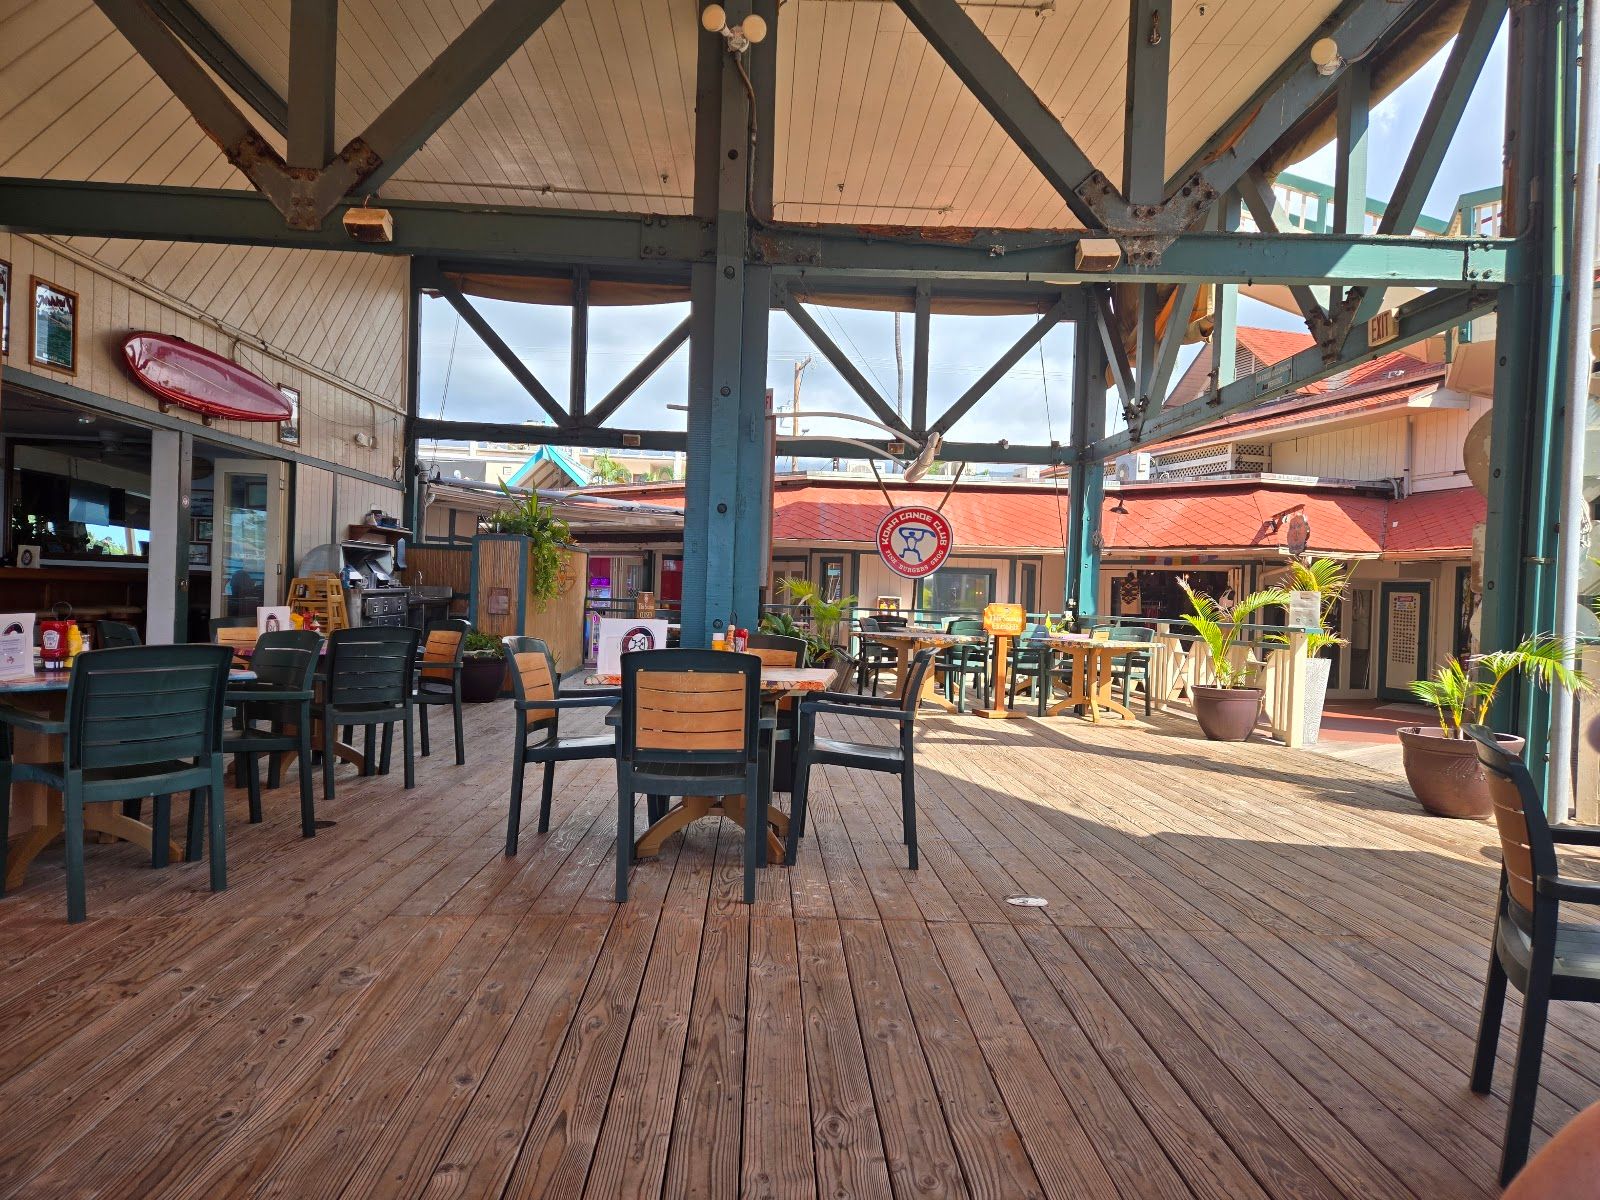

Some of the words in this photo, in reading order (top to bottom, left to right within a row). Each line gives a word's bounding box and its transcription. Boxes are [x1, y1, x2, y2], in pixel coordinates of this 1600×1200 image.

[1371, 311, 1389, 343] EXIT
[881, 518, 899, 545] KONA
[899, 511, 933, 523] CANOE
[933, 521, 947, 546] CLUB
[898, 564, 929, 573] BURGERS
